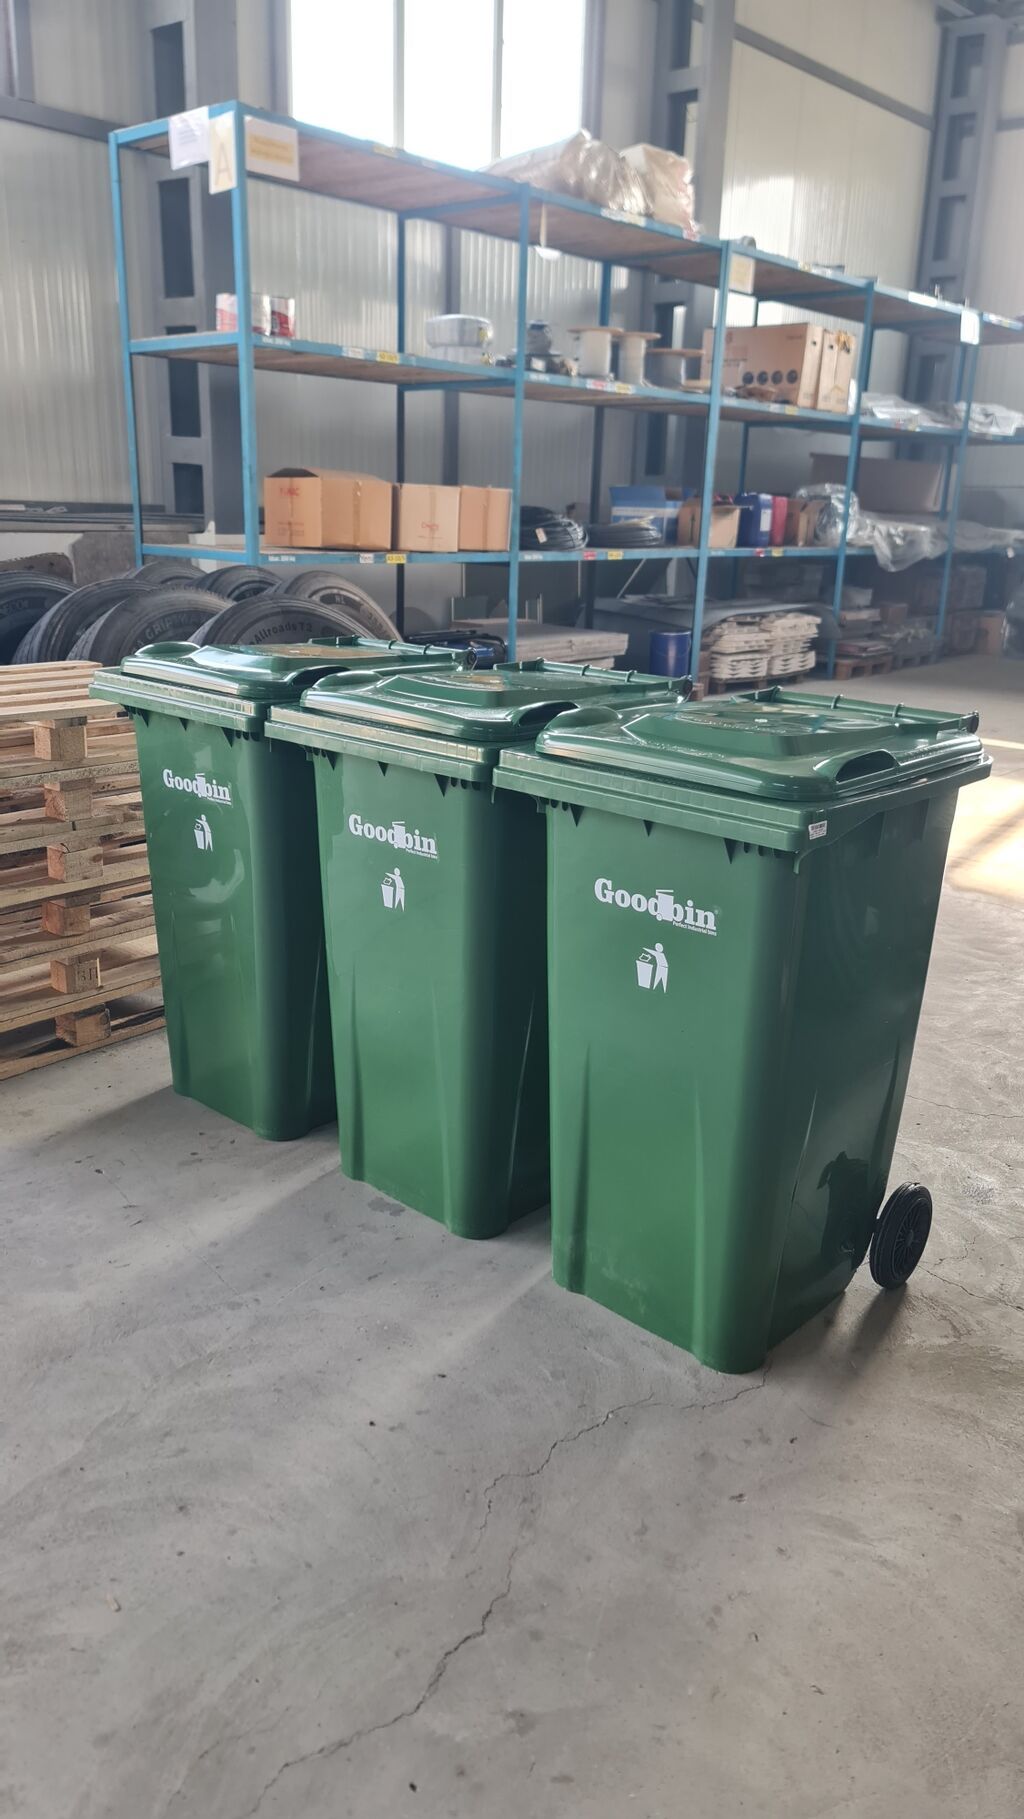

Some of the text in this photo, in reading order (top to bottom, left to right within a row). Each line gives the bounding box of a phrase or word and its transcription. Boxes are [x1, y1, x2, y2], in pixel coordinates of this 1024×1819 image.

[215, 141, 233, 186] A
[163, 768, 231, 801] Goodbin
[349, 813, 437, 855] Goodbin
[594, 878, 716, 930] Goodbin
